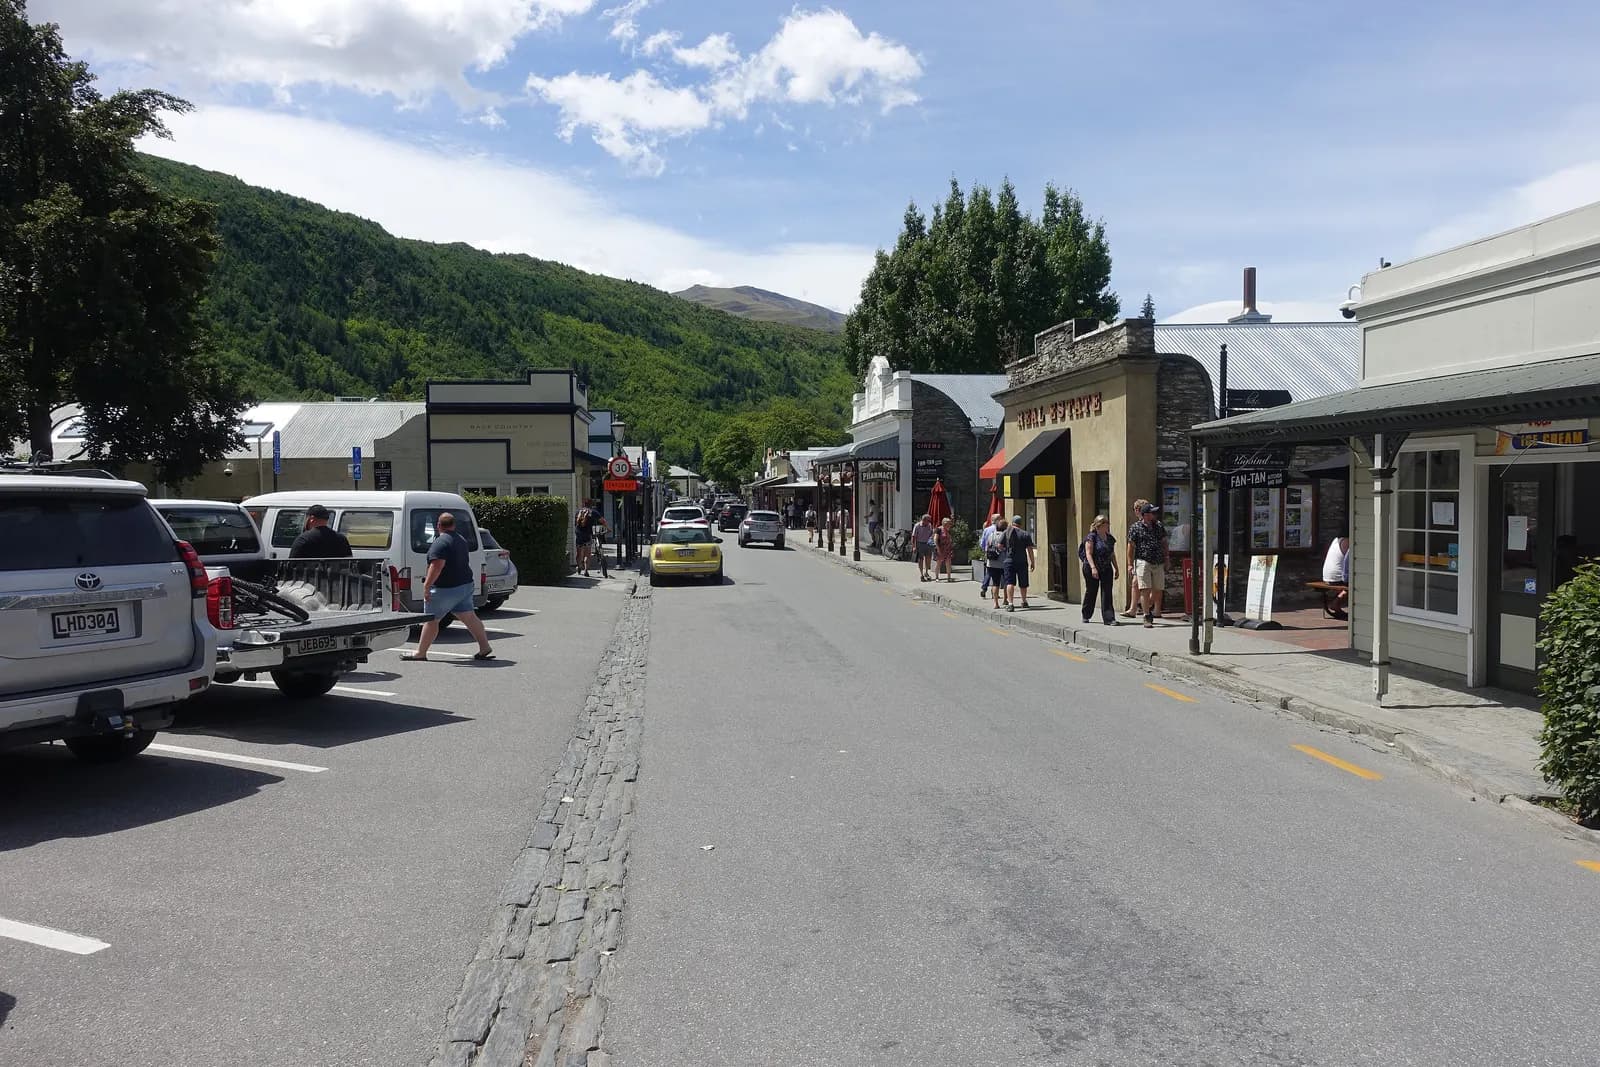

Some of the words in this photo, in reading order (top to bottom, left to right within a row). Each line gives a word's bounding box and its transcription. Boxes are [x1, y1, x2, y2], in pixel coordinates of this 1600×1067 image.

[1017, 406, 1046, 430] REAL
[1048, 392, 1102, 424] ESTATE
[1521, 433, 1538, 447] ICE
[1542, 431, 1583, 444] CREAM
[615, 463, 628, 473] 30
[862, 471, 894, 481] PHARMACY
[1230, 471, 1266, 488] FAN-TAN
[56, 612, 115, 633] LHD304
[301, 636, 336, 651] JEB695
